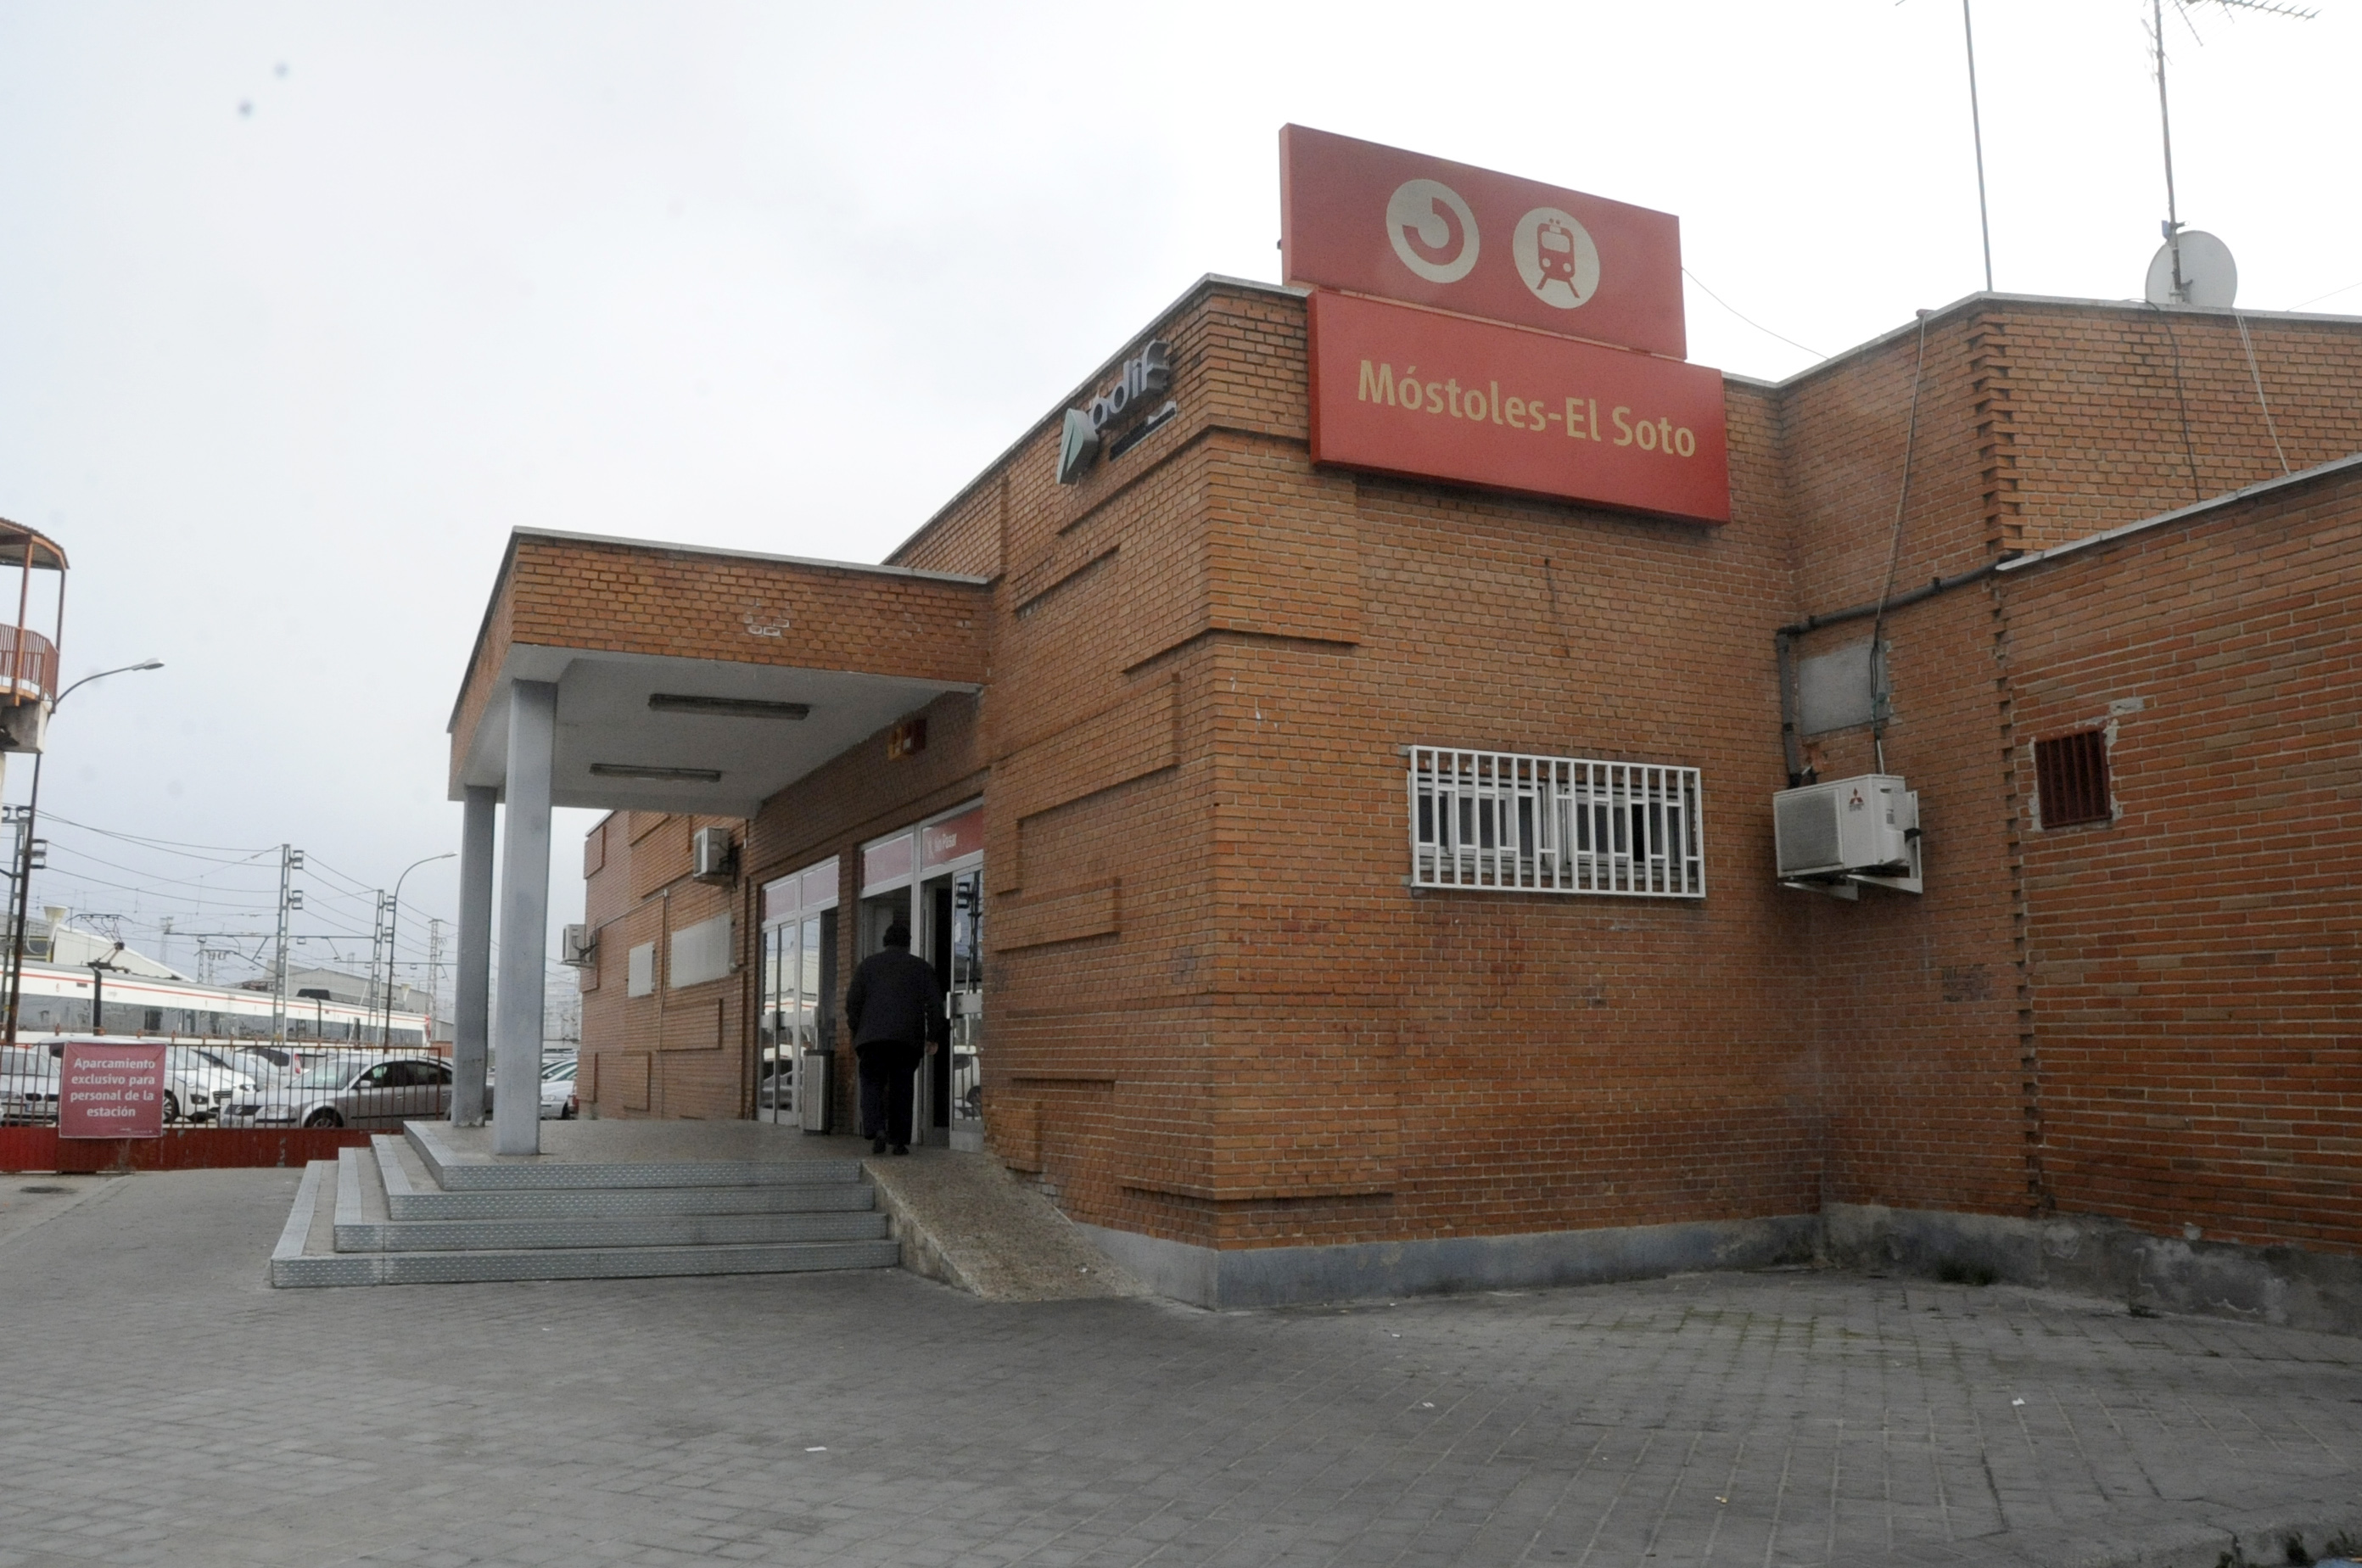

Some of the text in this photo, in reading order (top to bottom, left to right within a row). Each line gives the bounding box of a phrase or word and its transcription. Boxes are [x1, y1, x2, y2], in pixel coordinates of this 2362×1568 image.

[1357, 359, 1696, 457] Móstoles-El Soto
[74, 1057, 155, 1071] Aparcamiento
[71, 1073, 155, 1087] exclusivo para
[70, 1089, 154, 1102] personal de la
[87, 1106, 136, 1117] estación
